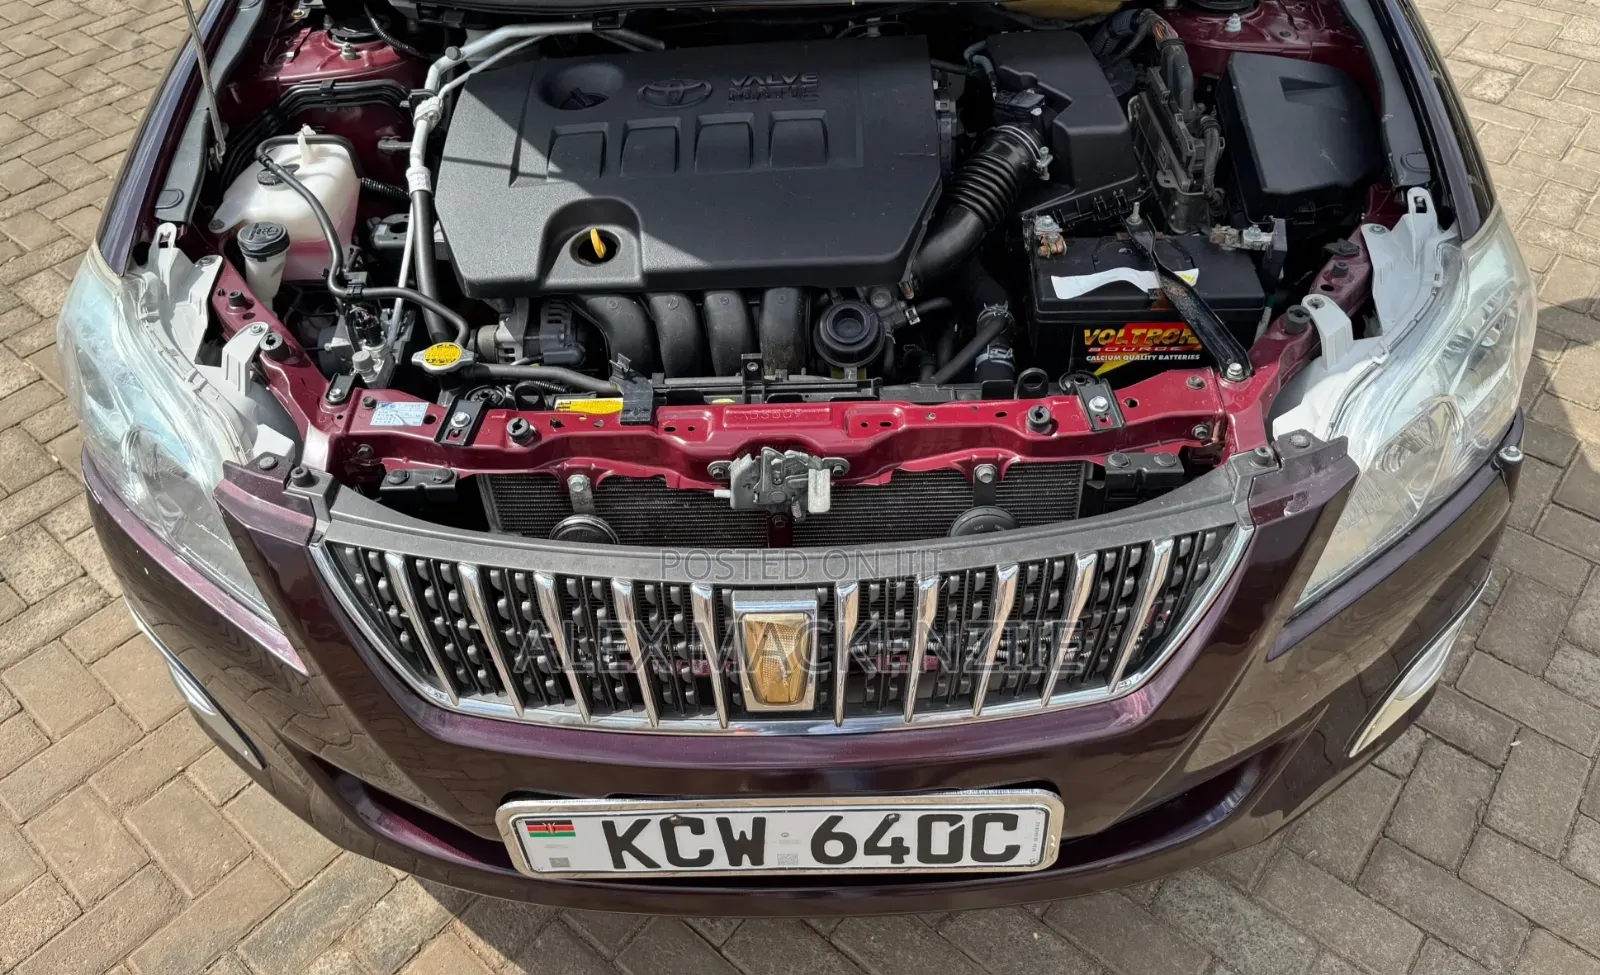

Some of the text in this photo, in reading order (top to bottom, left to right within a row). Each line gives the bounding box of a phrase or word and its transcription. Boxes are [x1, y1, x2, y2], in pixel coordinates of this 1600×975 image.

[731, 73, 818, 86] VALVE
[601, 814, 767, 869] KCW
[810, 813, 1021, 865] 640C
